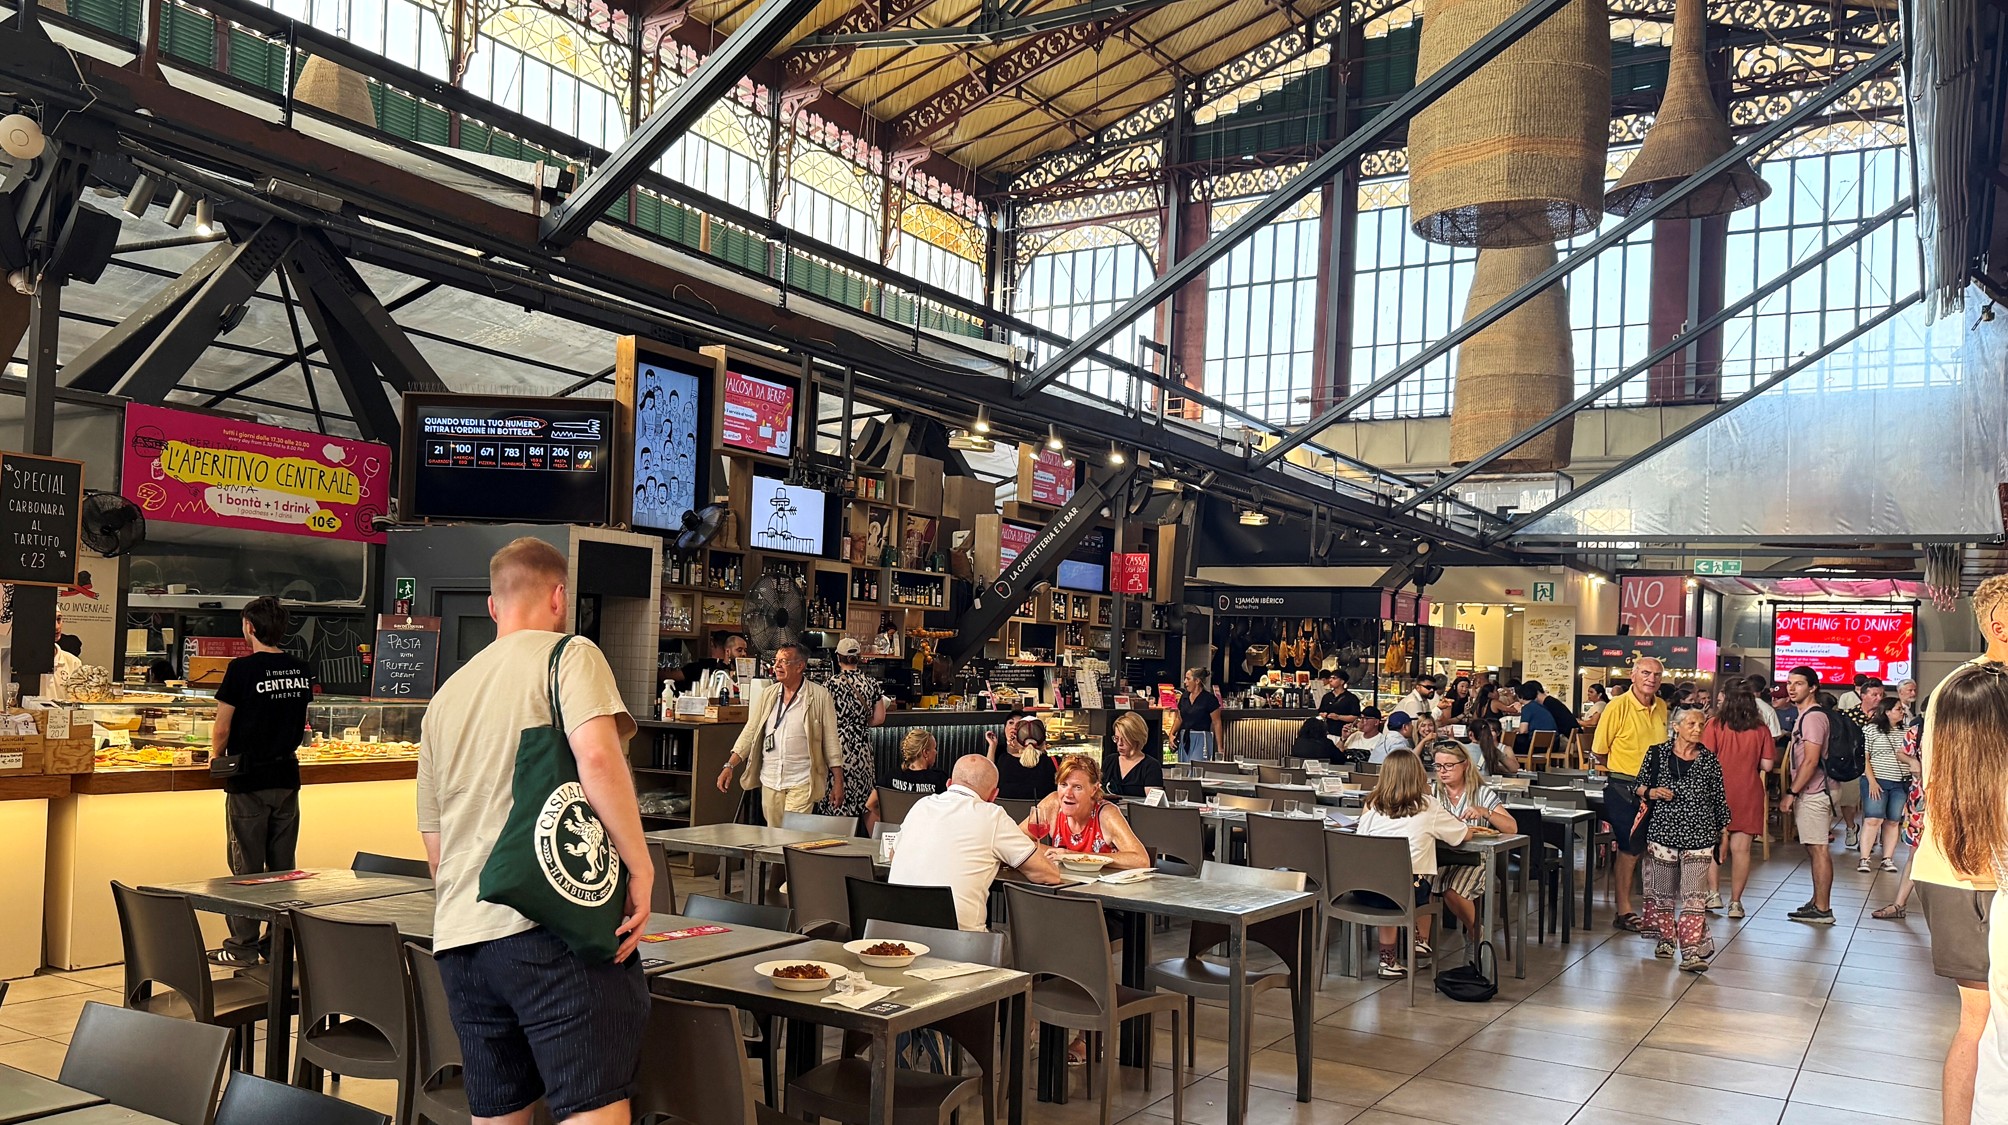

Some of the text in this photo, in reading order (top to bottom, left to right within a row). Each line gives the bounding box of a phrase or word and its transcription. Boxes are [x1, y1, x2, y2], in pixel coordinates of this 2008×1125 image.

[756, 385, 765, 400] DA
[767, 388, 786, 404] BERE?
[424, 417, 459, 426] QUANDO
[451, 426, 486, 434] L'ORDINE
[497, 428, 535, 436] BOTTEGA.
[434, 444, 592, 459] 21 100 671 783 861 206 691
[167, 447, 354, 496] L'APERITIVO CENTRALE
[13, 470, 66, 495] SPECIAL
[9, 499, 64, 516] CARBONARA
[218, 494, 222, 504] 1
[226, 494, 261, 508] bontà
[274, 500, 278, 511] 1
[282, 500, 311, 514] drink
[31, 520, 42, 531] AL
[312, 516, 336, 528] 10€
[13, 532, 60, 548] TARTUFO
[1009, 570, 1020, 581] LA
[1017, 532, 1056, 572] CAFFETTERIA
[1058, 520, 1067, 529] IL
[1064, 507, 1079, 523] BAR
[21, 552, 45, 569] € 23
[1125, 556, 1147, 566] CASSA
[1260, 596, 1284, 604] IBÉRICO
[1624, 580, 1664, 608] NO
[72, 603, 110, 614] INVERNALE
[1622, 612, 1682, 636] EXIT
[1776, 617, 1901, 631] SOMETHING TO DRINK?
[387, 634, 421, 649] PASTA
[380, 659, 424, 671] TRUFFLE
[256, 677, 309, 693] CENTRALE
[390, 682, 411, 695] 15
[916, 783, 936, 792] ROSES
[540, 786, 584, 830] CASUAL
